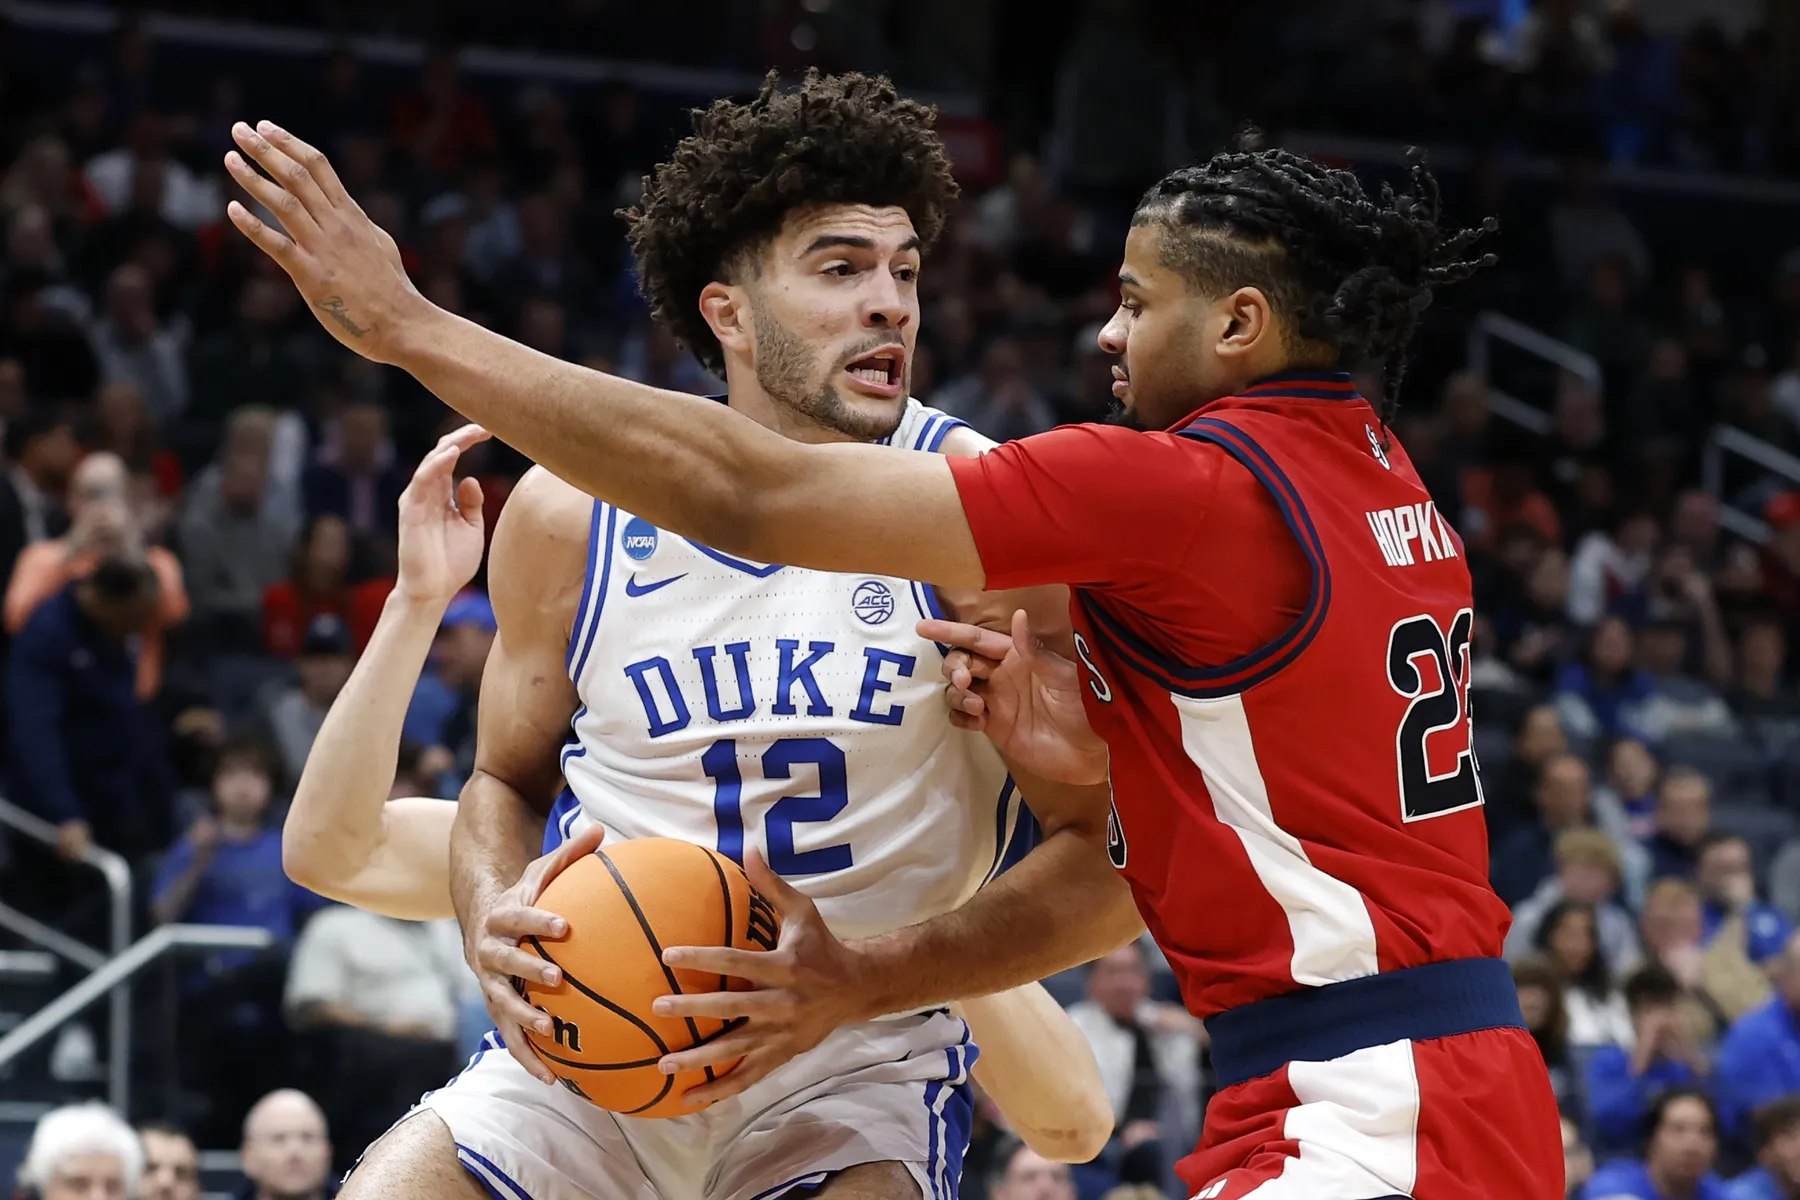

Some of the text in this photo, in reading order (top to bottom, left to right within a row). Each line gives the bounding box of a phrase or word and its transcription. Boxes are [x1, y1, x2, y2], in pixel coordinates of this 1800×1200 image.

[626, 536, 655, 549] NCAA
[1365, 500, 1459, 567] HOPKI
[858, 594, 891, 606] ACC
[623, 638, 917, 739] DUKE
[700, 737, 854, 876] 12
